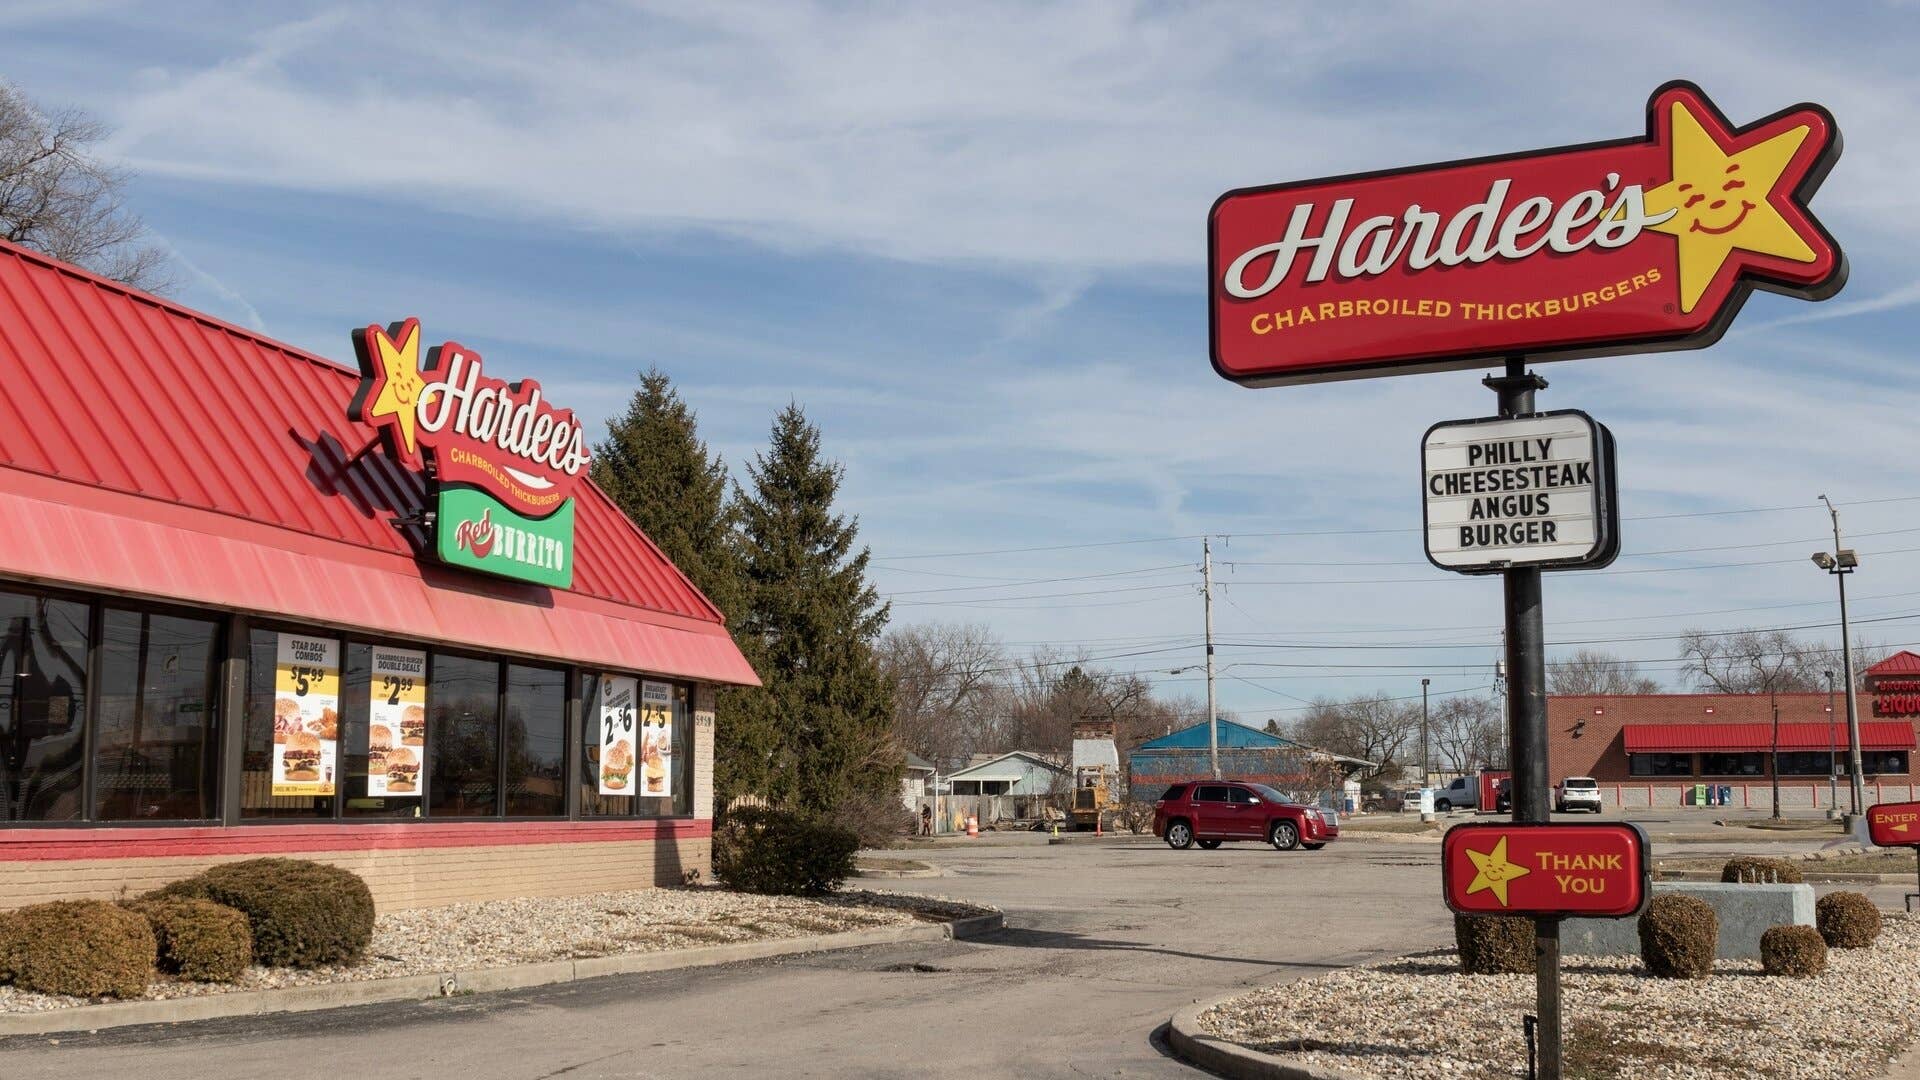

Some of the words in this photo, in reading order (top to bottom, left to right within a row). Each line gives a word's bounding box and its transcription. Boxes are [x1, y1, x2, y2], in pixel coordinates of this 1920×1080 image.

[1224, 172, 1679, 299] Hardee's
[1250, 299, 1452, 335] CHARBROILED
[1460, 268, 1662, 321] THICKBURGERS
[416, 353, 591, 475] Hardee's
[1468, 438, 1553, 466] PHILLY
[450, 447, 510, 489] CHARBROILED
[510, 483, 560, 505] THICKBURGERS
[1429, 462, 1593, 496] CHEESESTEAK
[1469, 493, 1550, 520] ANGUS
[455, 507, 495, 559] Red
[492, 523, 564, 571] BURRITO
[1459, 520, 1558, 547] BURGER
[291, 640, 309, 651] STAR
[309, 642, 327, 653] DEAL
[295, 651, 323, 662] COMBOS
[378, 660, 402, 671] DOUBLE
[402, 662, 421, 673] DEALS
[1875, 813, 1918, 824] ENTER
[1536, 852, 1623, 870] THANK
[1555, 875, 1605, 894] YOU
